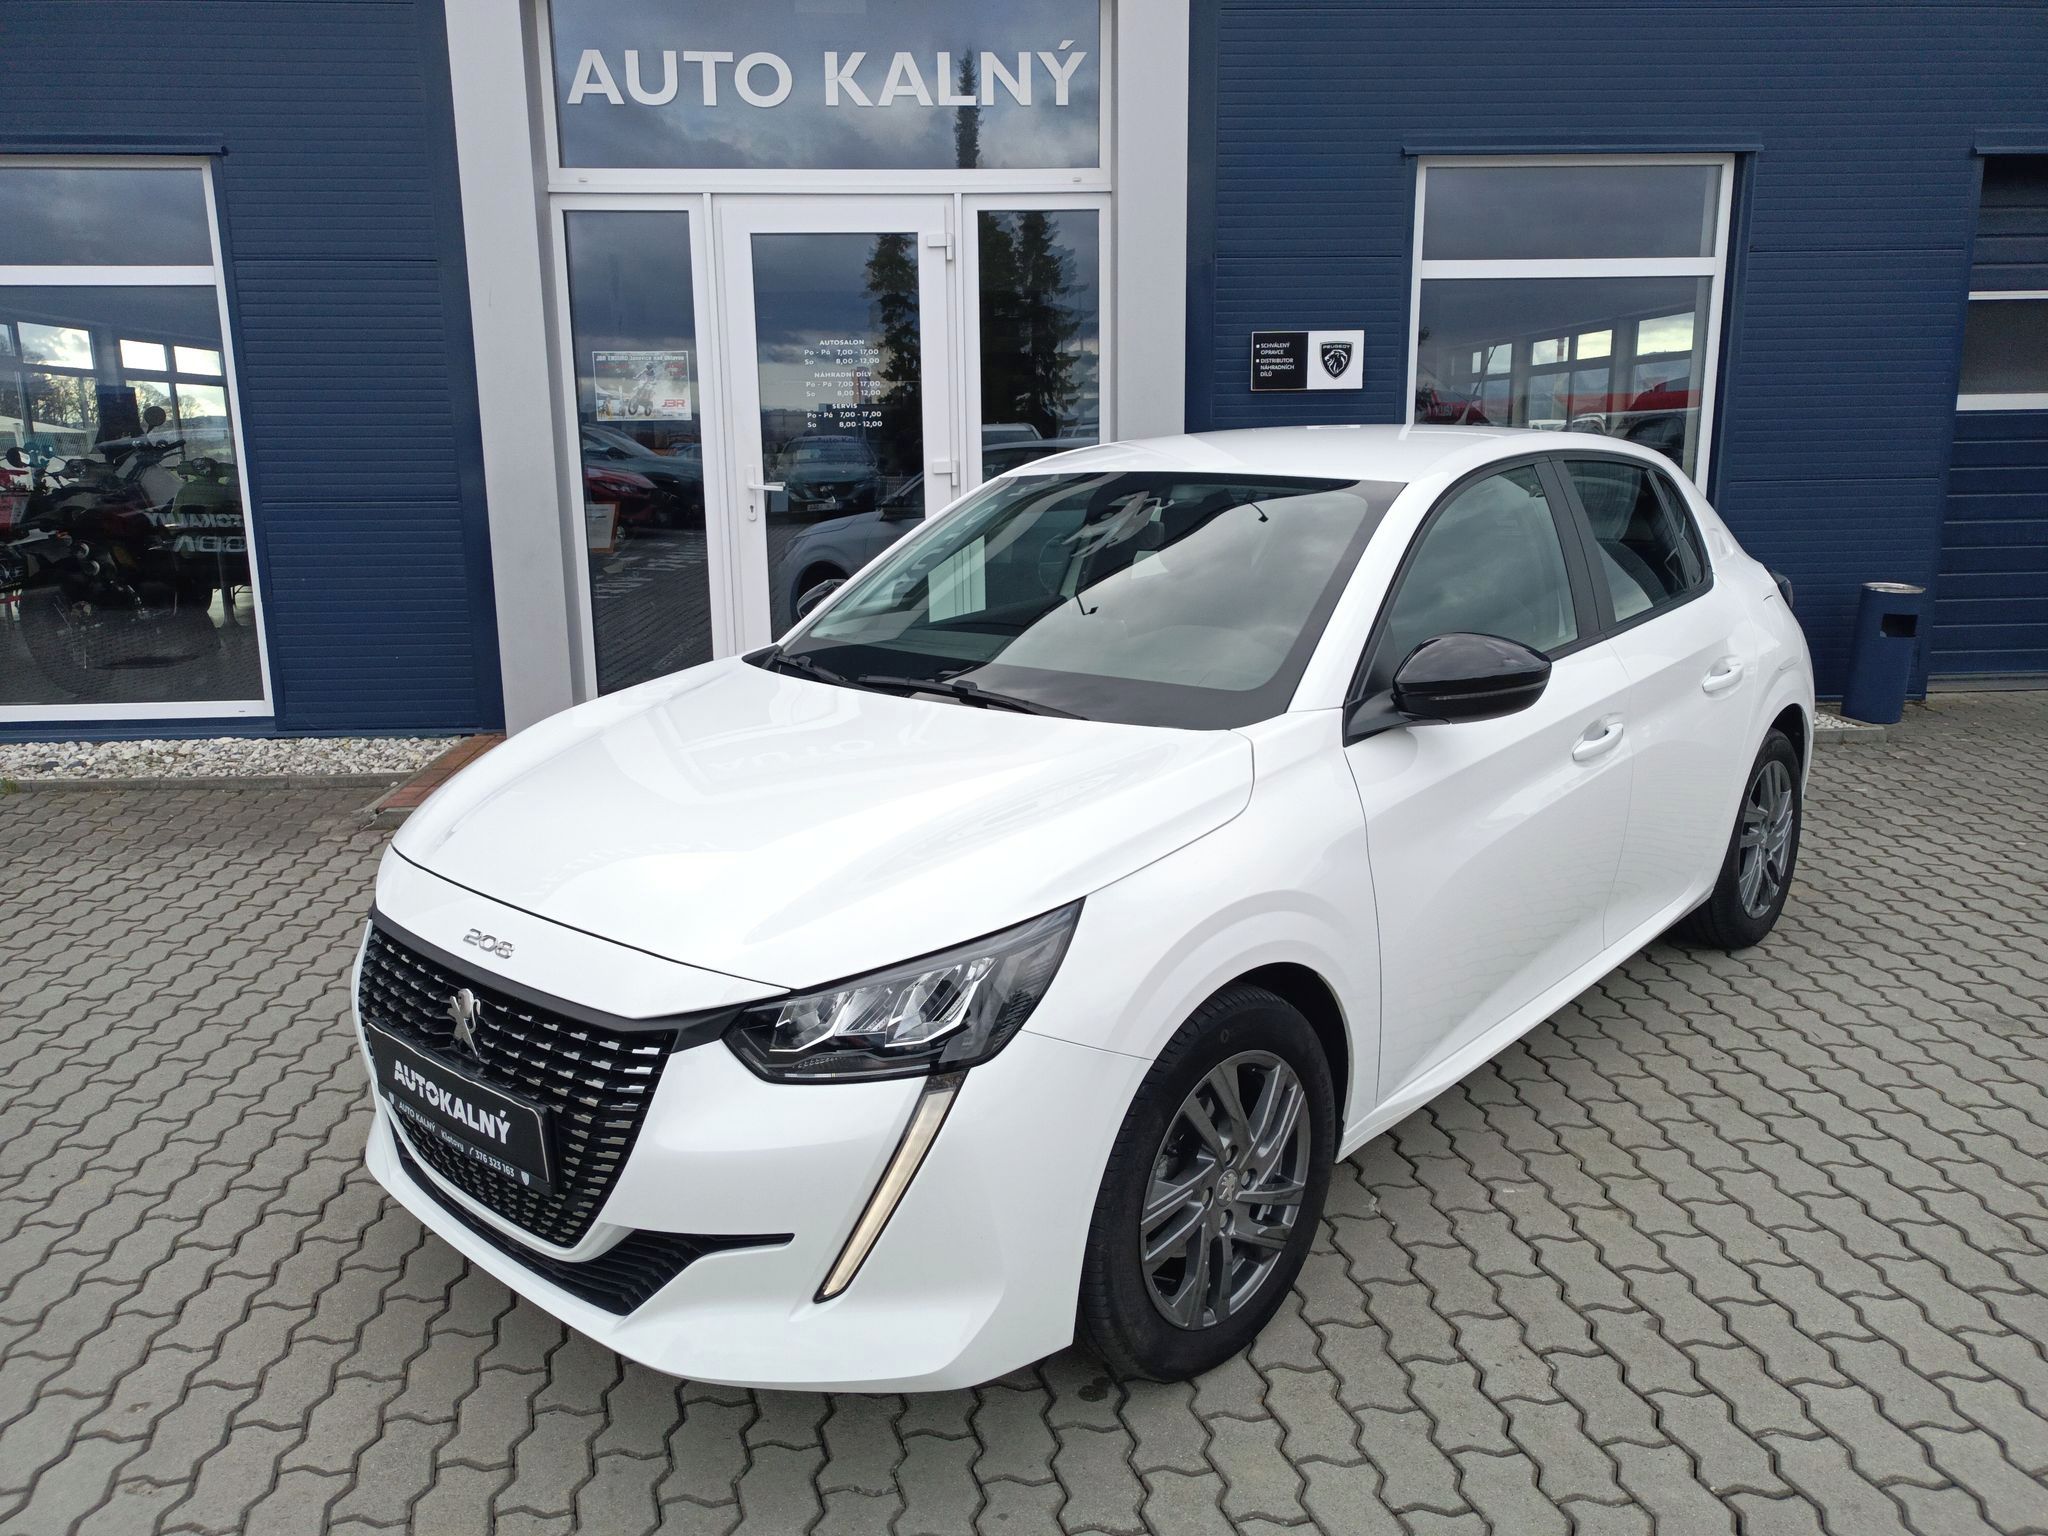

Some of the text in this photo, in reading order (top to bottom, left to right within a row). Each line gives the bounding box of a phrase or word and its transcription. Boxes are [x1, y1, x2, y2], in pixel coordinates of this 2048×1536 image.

[567, 39, 1088, 108] AUTO KALNÝ
[836, 348, 853, 357] 7,00
[860, 348, 879, 356] 17,00
[804, 358, 814, 366] So
[860, 357, 880, 366] 12,00
[838, 380, 854, 388] 7,00
[860, 380, 880, 388] 17,00
[840, 411, 856, 419] 7,00
[839, 421, 856, 429] 8,00
[463, 928, 515, 959] 208
[394, 1060, 511, 1144] AUTOKALNÝ
[399, 1101, 415, 1117] AUTO
[415, 1112, 436, 1132] KALNÝ
[475, 1149, 488, 1164] 376
[488, 1156, 501, 1170] 323
[502, 1163, 515, 1177] 163
